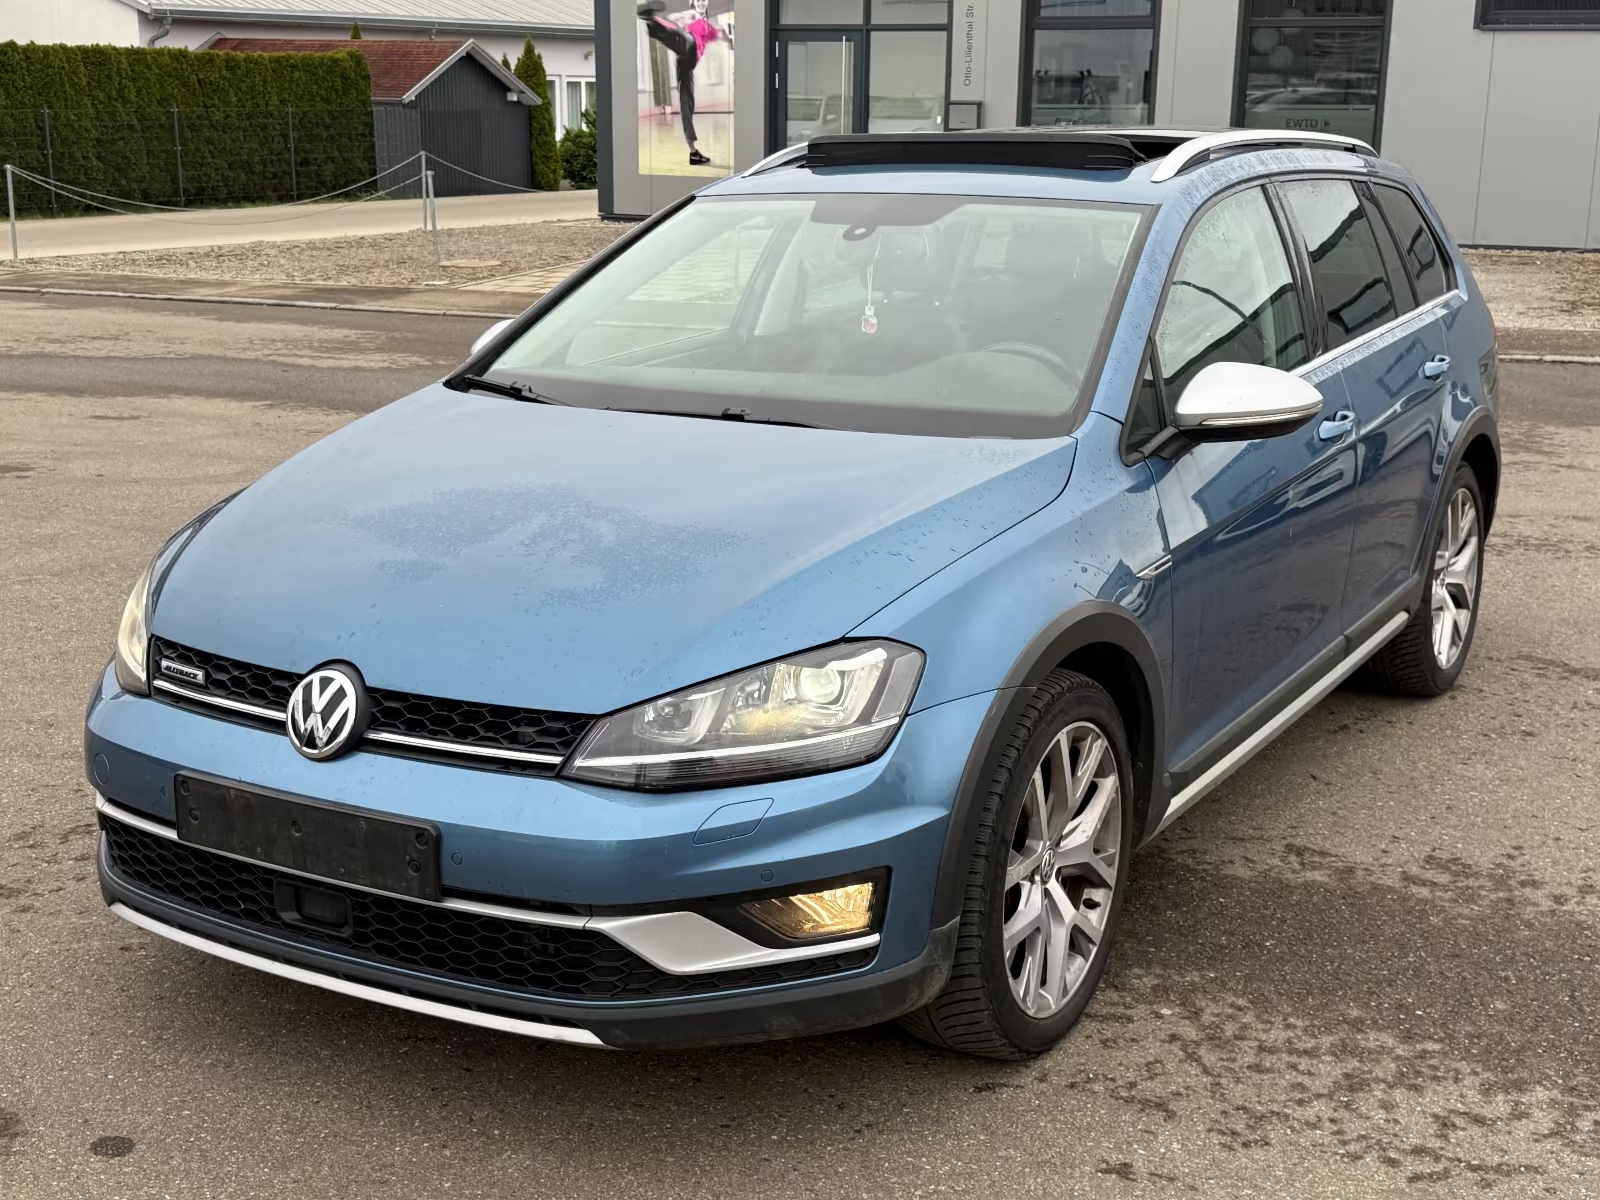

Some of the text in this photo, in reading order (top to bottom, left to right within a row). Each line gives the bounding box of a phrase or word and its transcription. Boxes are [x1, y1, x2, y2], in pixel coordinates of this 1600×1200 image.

[963, 2, 975, 87] Otto-Lilienthal Str.
[1285, 118, 1319, 128] EWTO
[163, 664, 200, 680] ALLTRACK
